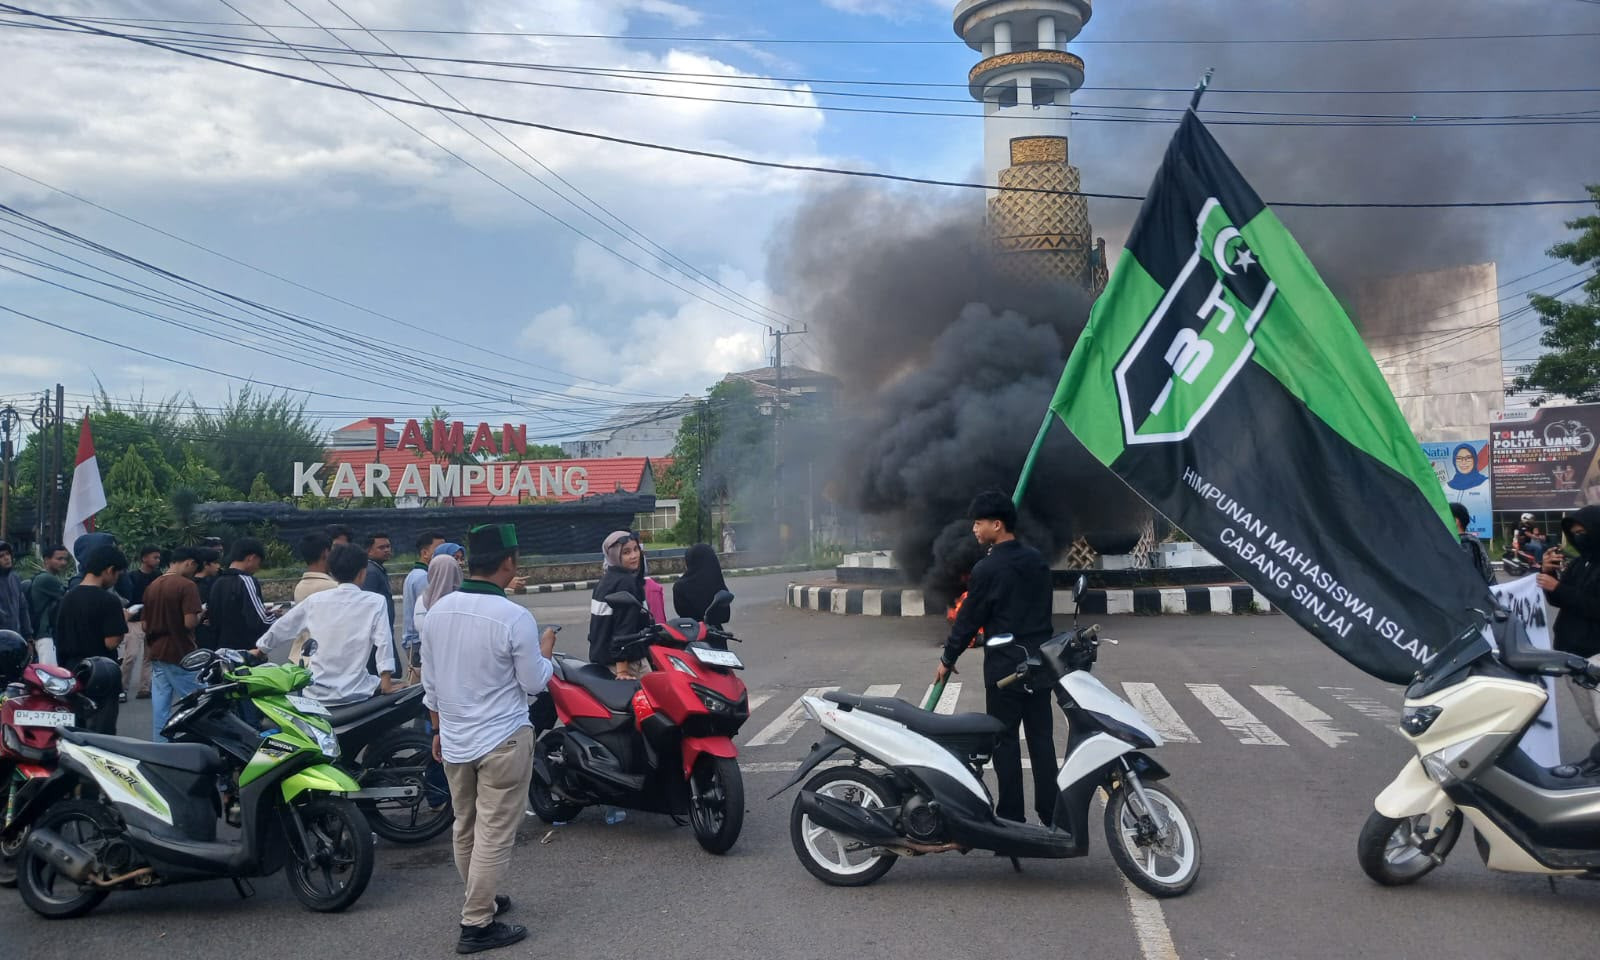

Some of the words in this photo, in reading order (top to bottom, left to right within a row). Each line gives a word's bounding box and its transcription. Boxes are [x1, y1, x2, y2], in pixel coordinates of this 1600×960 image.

[368, 417, 527, 455] TAMAN
[1493, 430, 1534, 440] TOLAK
[1544, 436, 1581, 446] UANG
[1422, 447, 1450, 457] Natal
[293, 462, 589, 498] KARAMPUANG
[1182, 466, 1268, 538] HIMPUNAN
[1265, 532, 1374, 625] MAHASISWA
[1219, 527, 1291, 589] CABANG
[1291, 584, 1354, 638] SINJAI
[268, 739, 293, 751] HONDA
